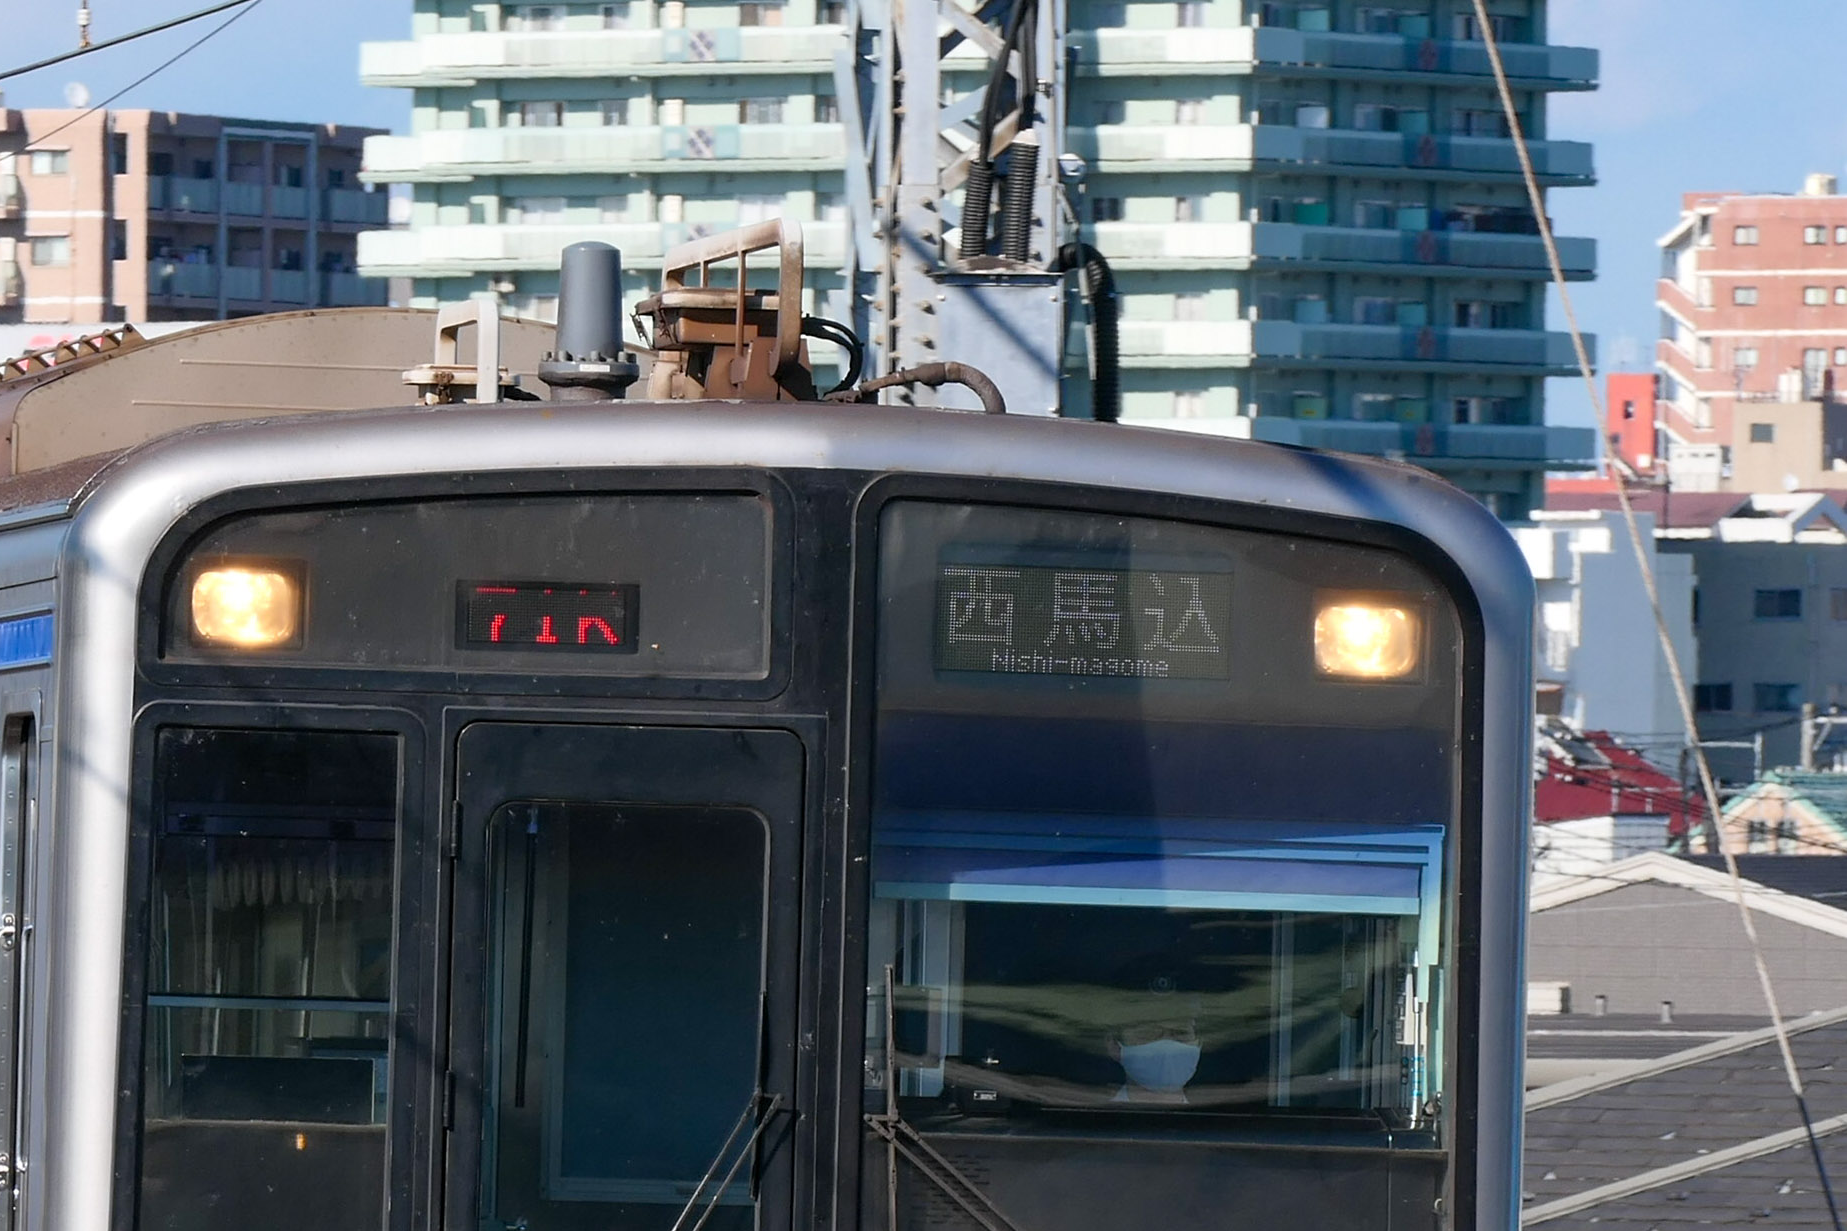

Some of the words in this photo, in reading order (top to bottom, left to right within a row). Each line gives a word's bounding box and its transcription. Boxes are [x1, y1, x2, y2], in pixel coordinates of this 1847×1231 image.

[944, 568, 1220, 654] 西馬込
[991, 649, 1170, 678] Nishi-magome
